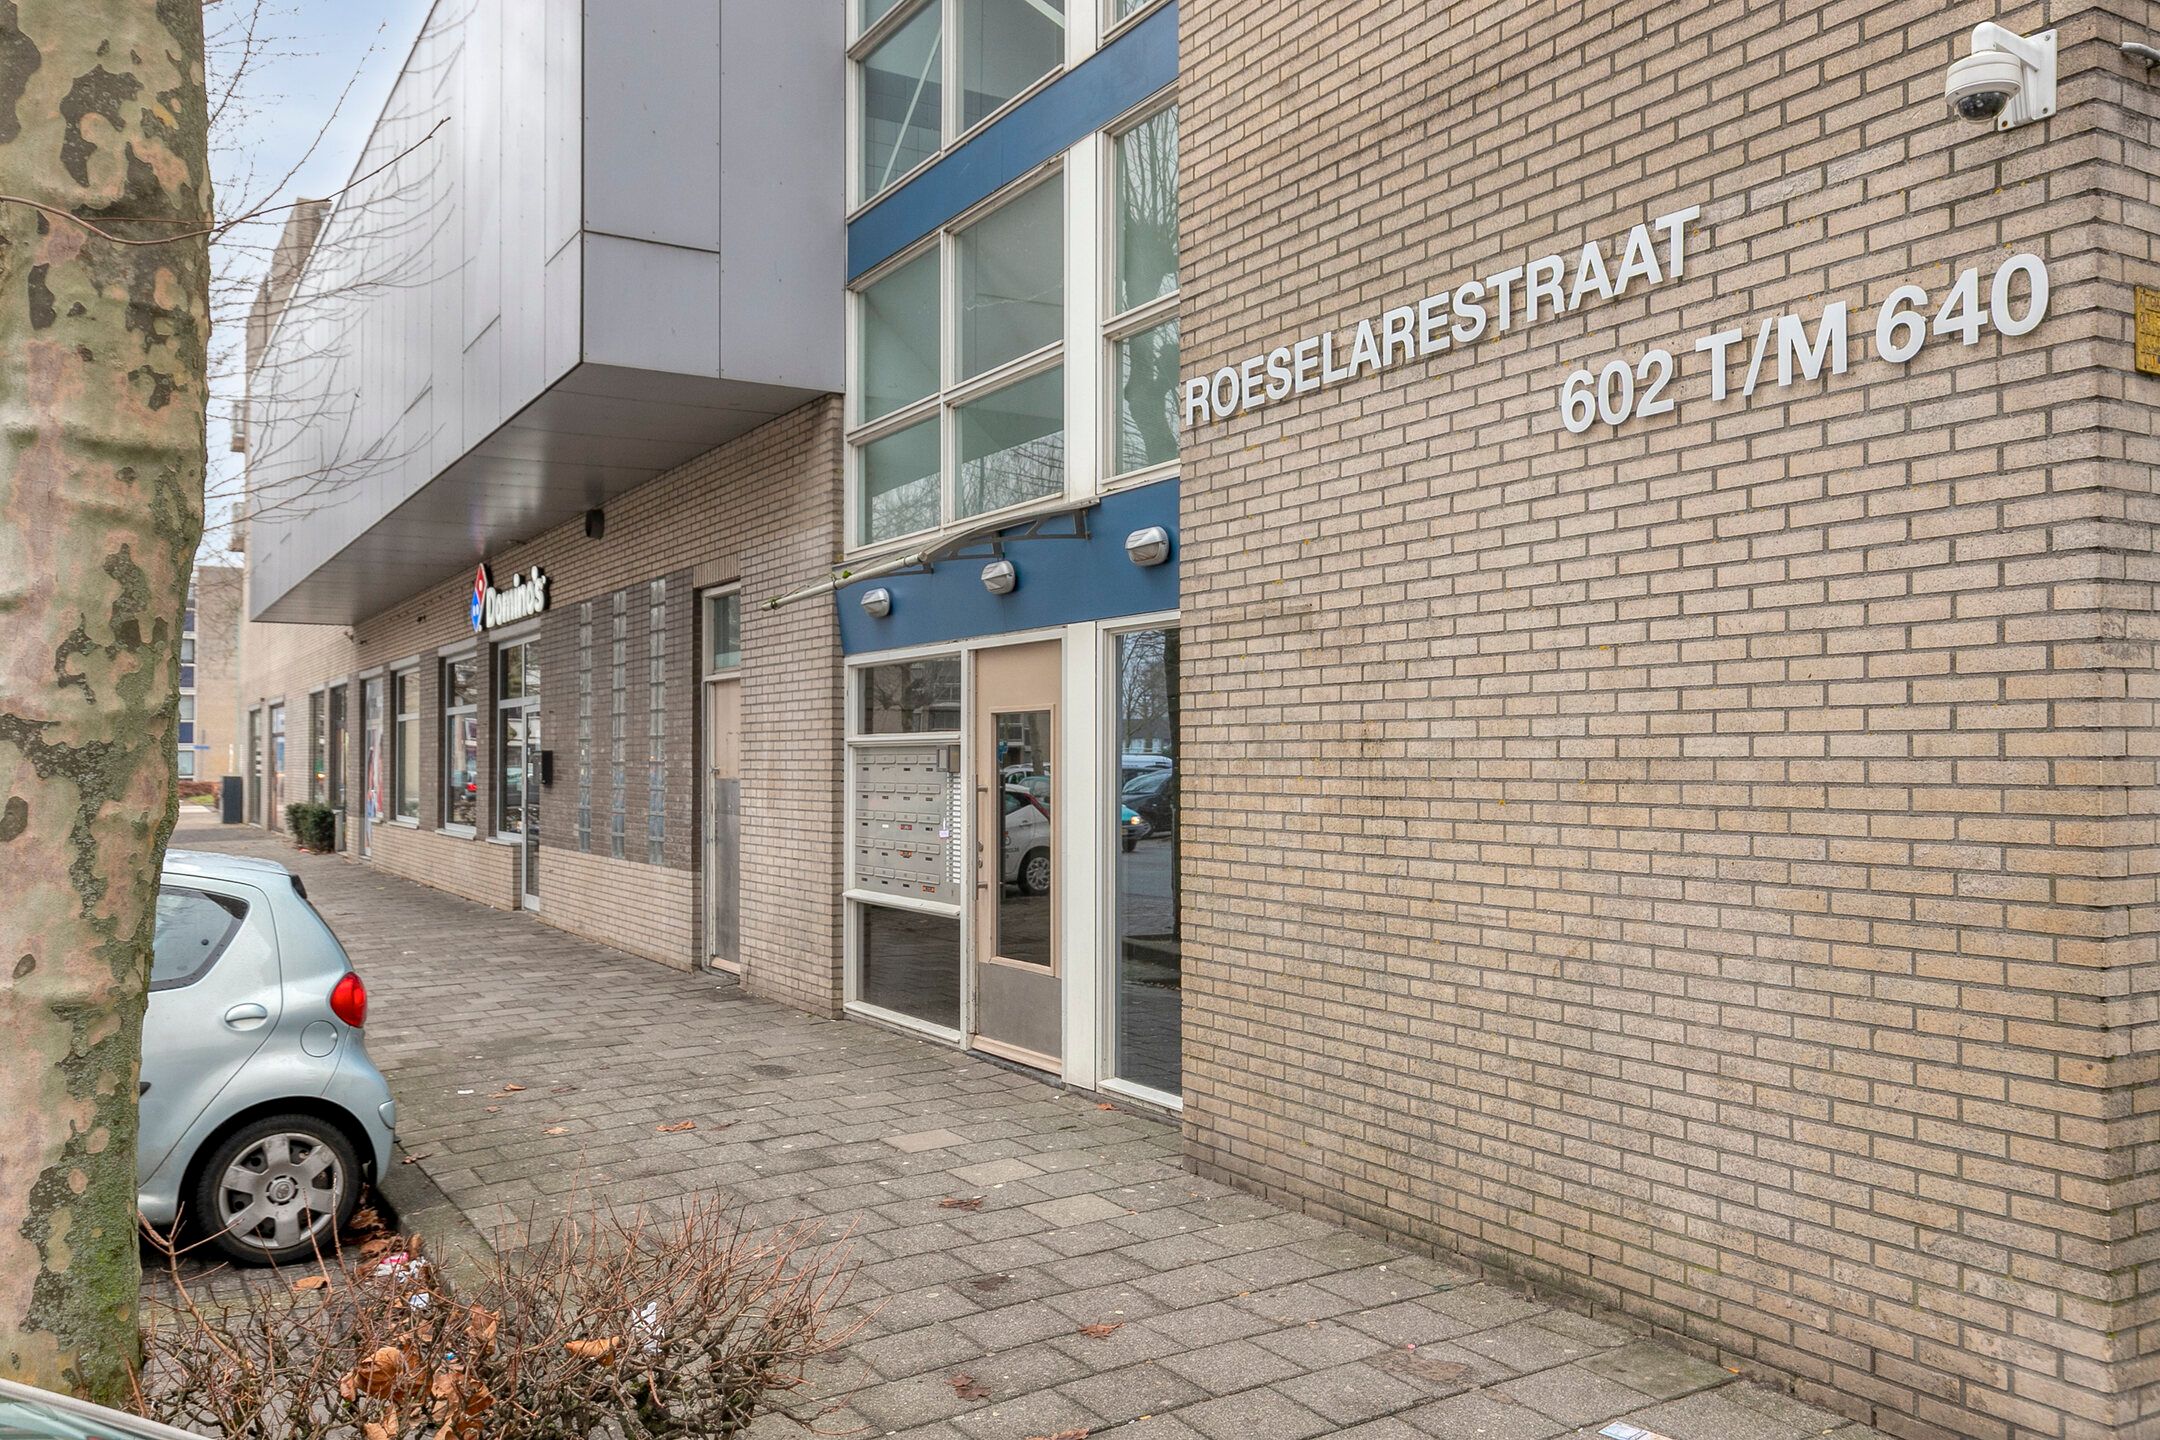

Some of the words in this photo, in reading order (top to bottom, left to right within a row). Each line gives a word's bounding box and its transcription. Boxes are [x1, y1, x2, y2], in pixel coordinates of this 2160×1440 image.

[1185, 204, 1701, 426] ROESELARESTRAAT
[1560, 348, 1675, 434] 602
[1695, 300, 1848, 402] T/M
[1875, 252, 2051, 364] 640
[486, 565, 546, 628] Domino's
